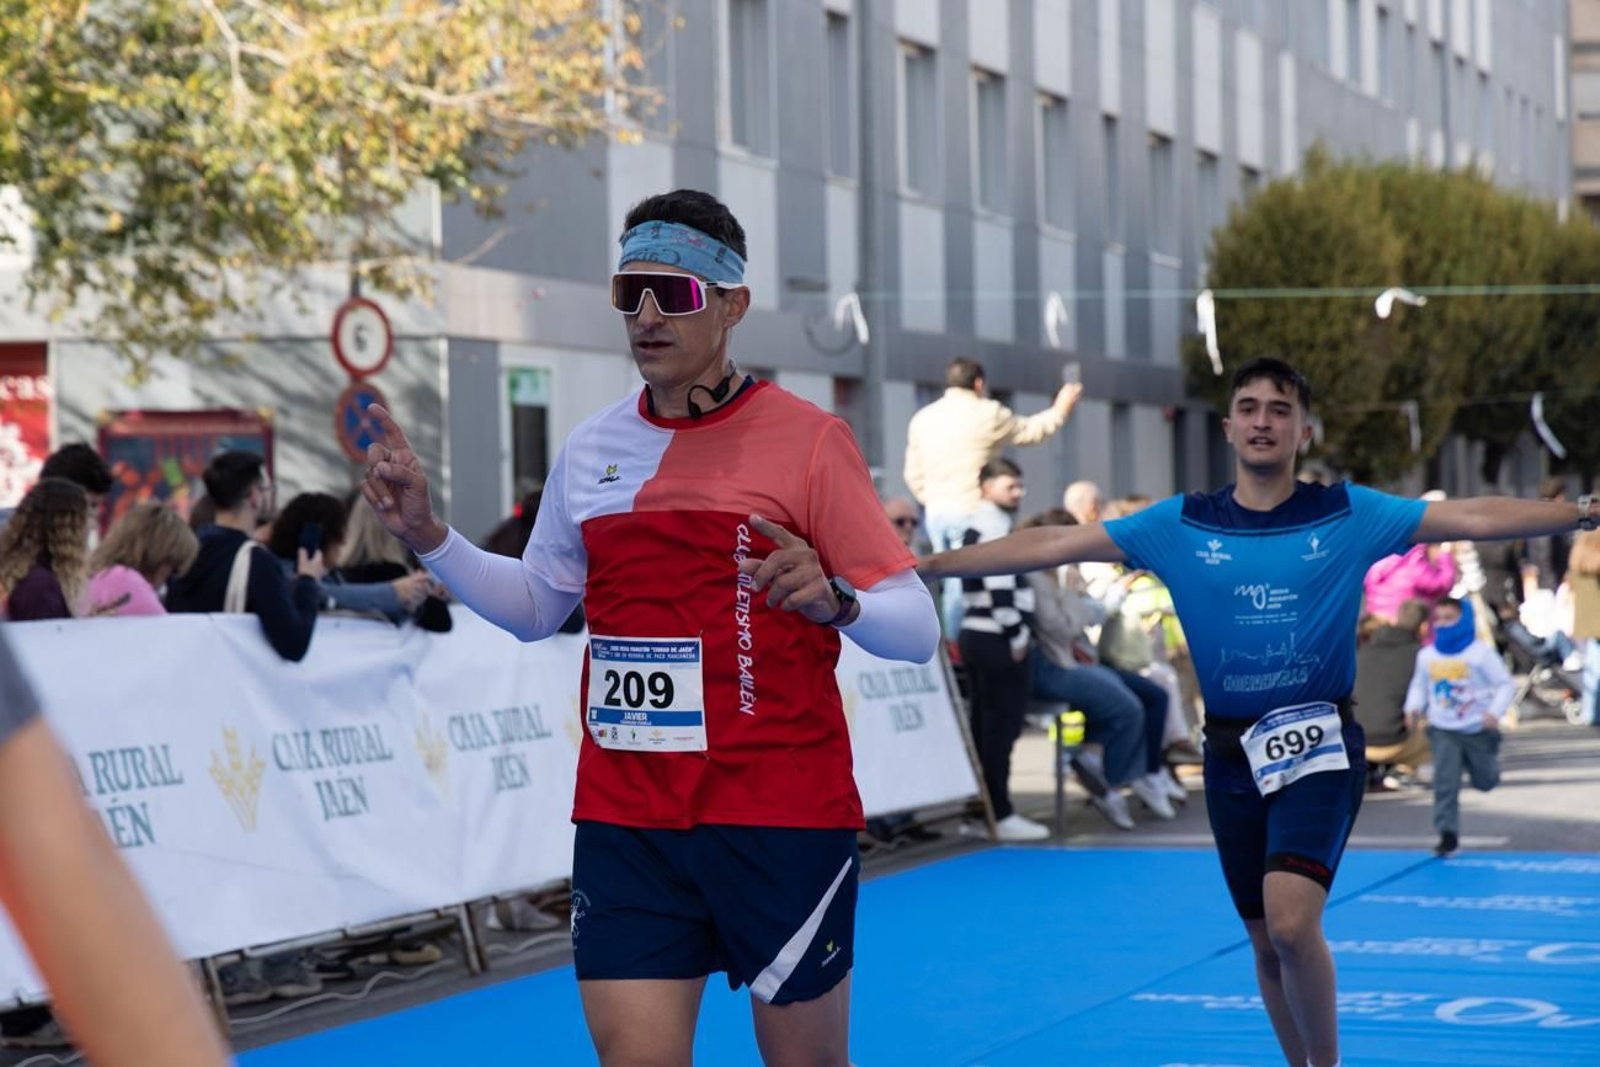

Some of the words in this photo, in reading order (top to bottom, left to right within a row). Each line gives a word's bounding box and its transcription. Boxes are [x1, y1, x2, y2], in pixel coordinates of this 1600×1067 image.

[603, 669, 675, 709] 209
[319, 724, 394, 768] RURAL
[1265, 725, 1324, 761] 699
[88, 744, 184, 796] RURAL
[314, 771, 371, 822] JAÉN
